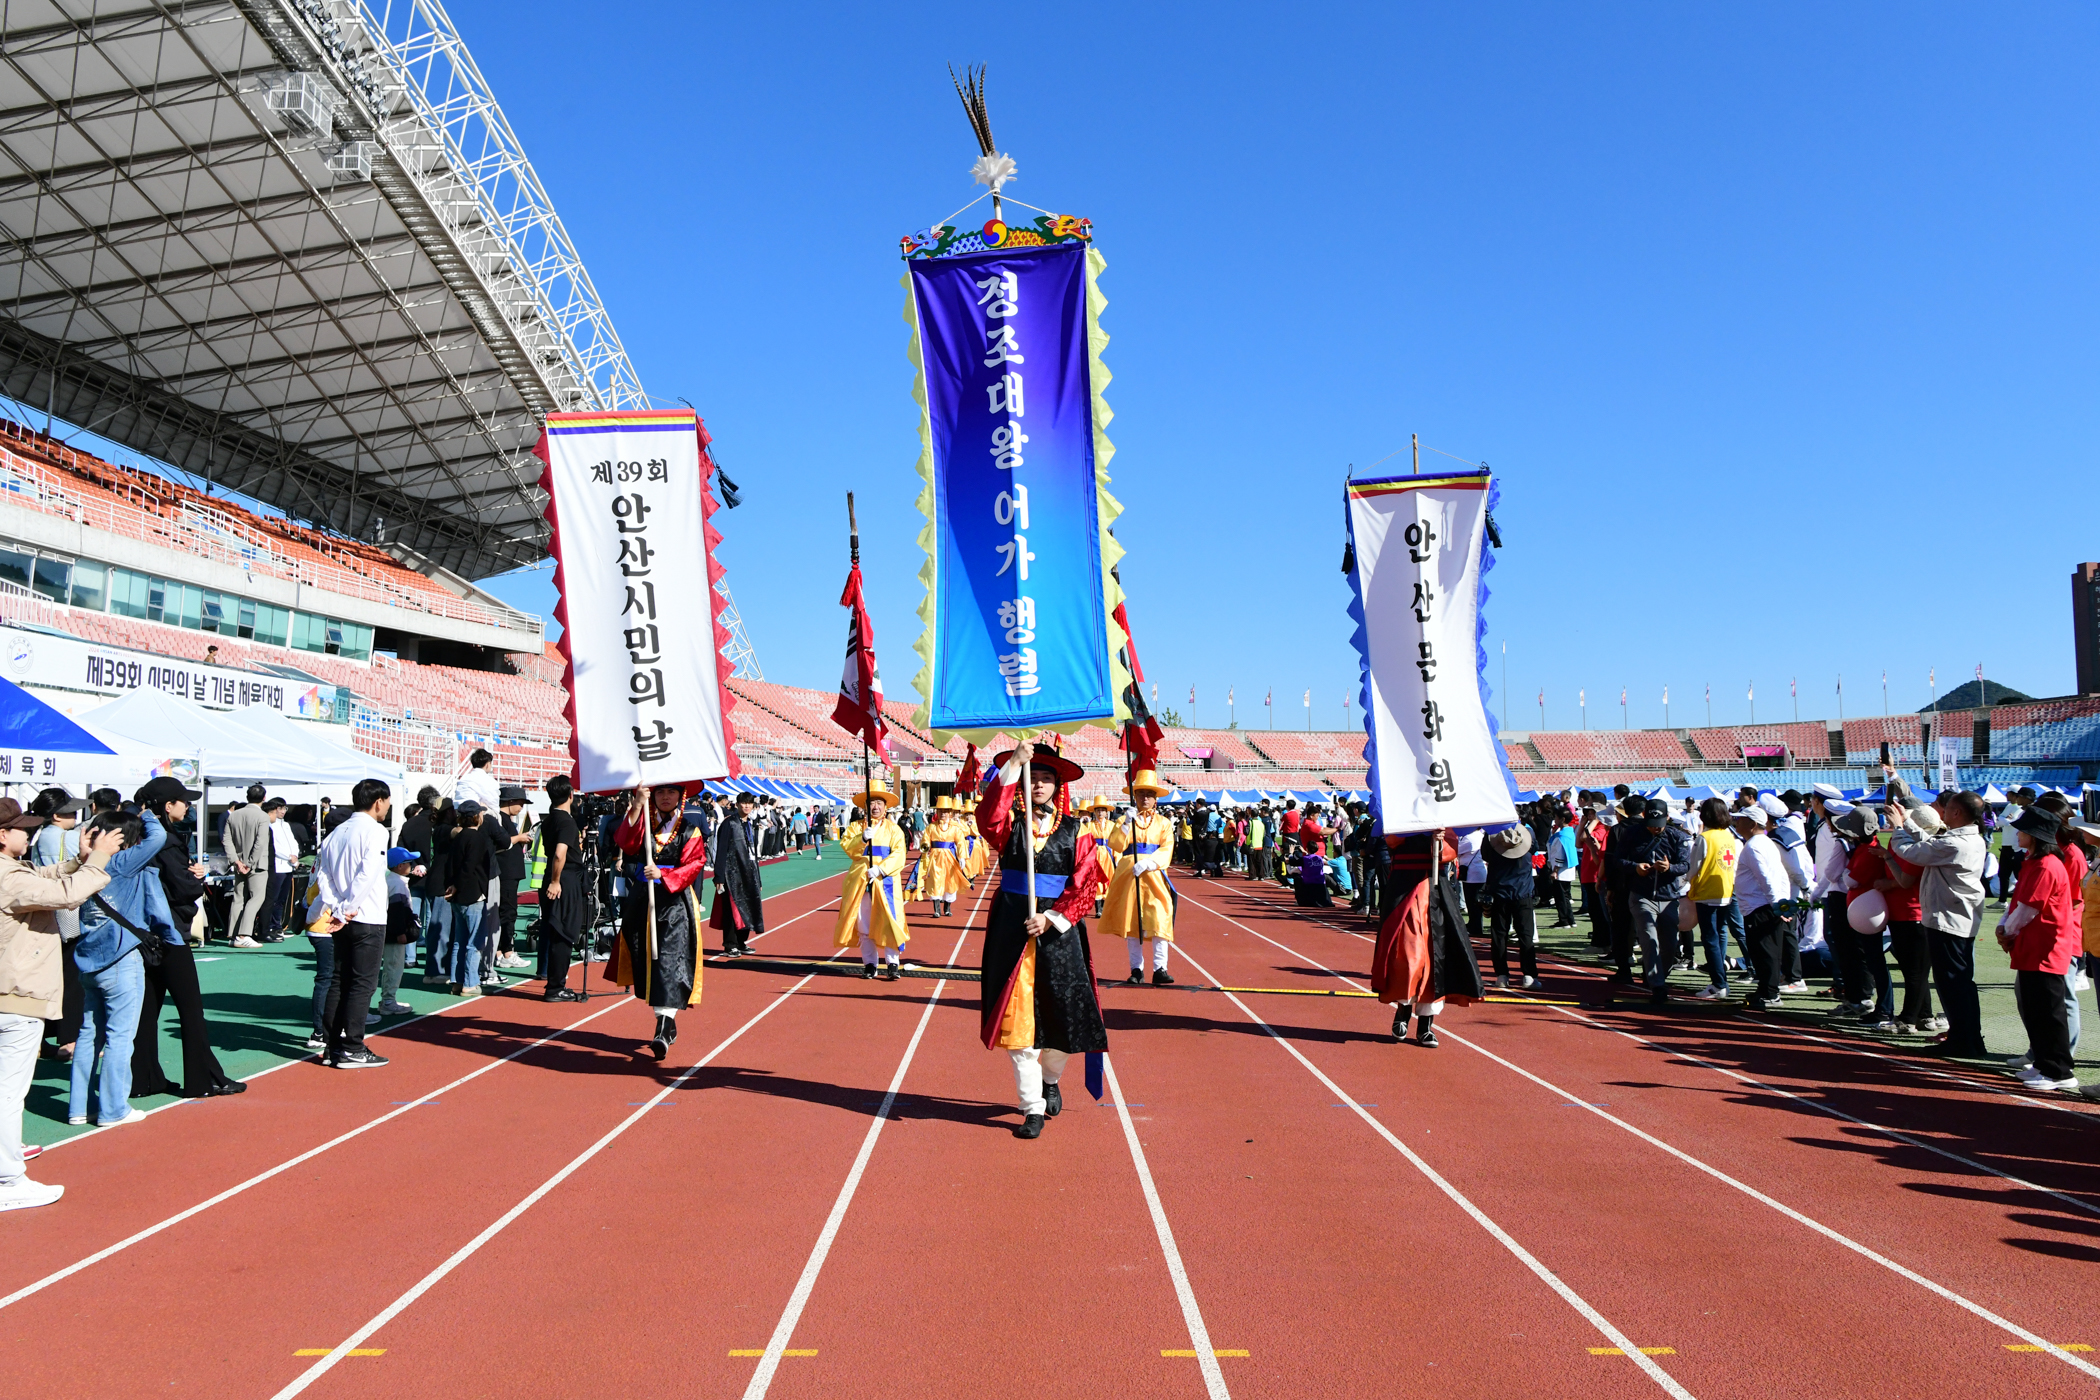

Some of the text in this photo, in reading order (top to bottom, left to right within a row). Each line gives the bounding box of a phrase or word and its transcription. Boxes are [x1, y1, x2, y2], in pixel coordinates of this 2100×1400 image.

[590, 458, 669, 486] 제39회
[976, 271, 1042, 697] 정조대왕 어가 행렬
[86, 655, 142, 689] 제39회
[147, 665, 190, 699] 시민의
[193, 673, 207, 701] 날
[211, 676, 235, 706] 기념
[611, 493, 674, 762] 안산시민의 날
[1404, 518, 1456, 803] 안산문화원
